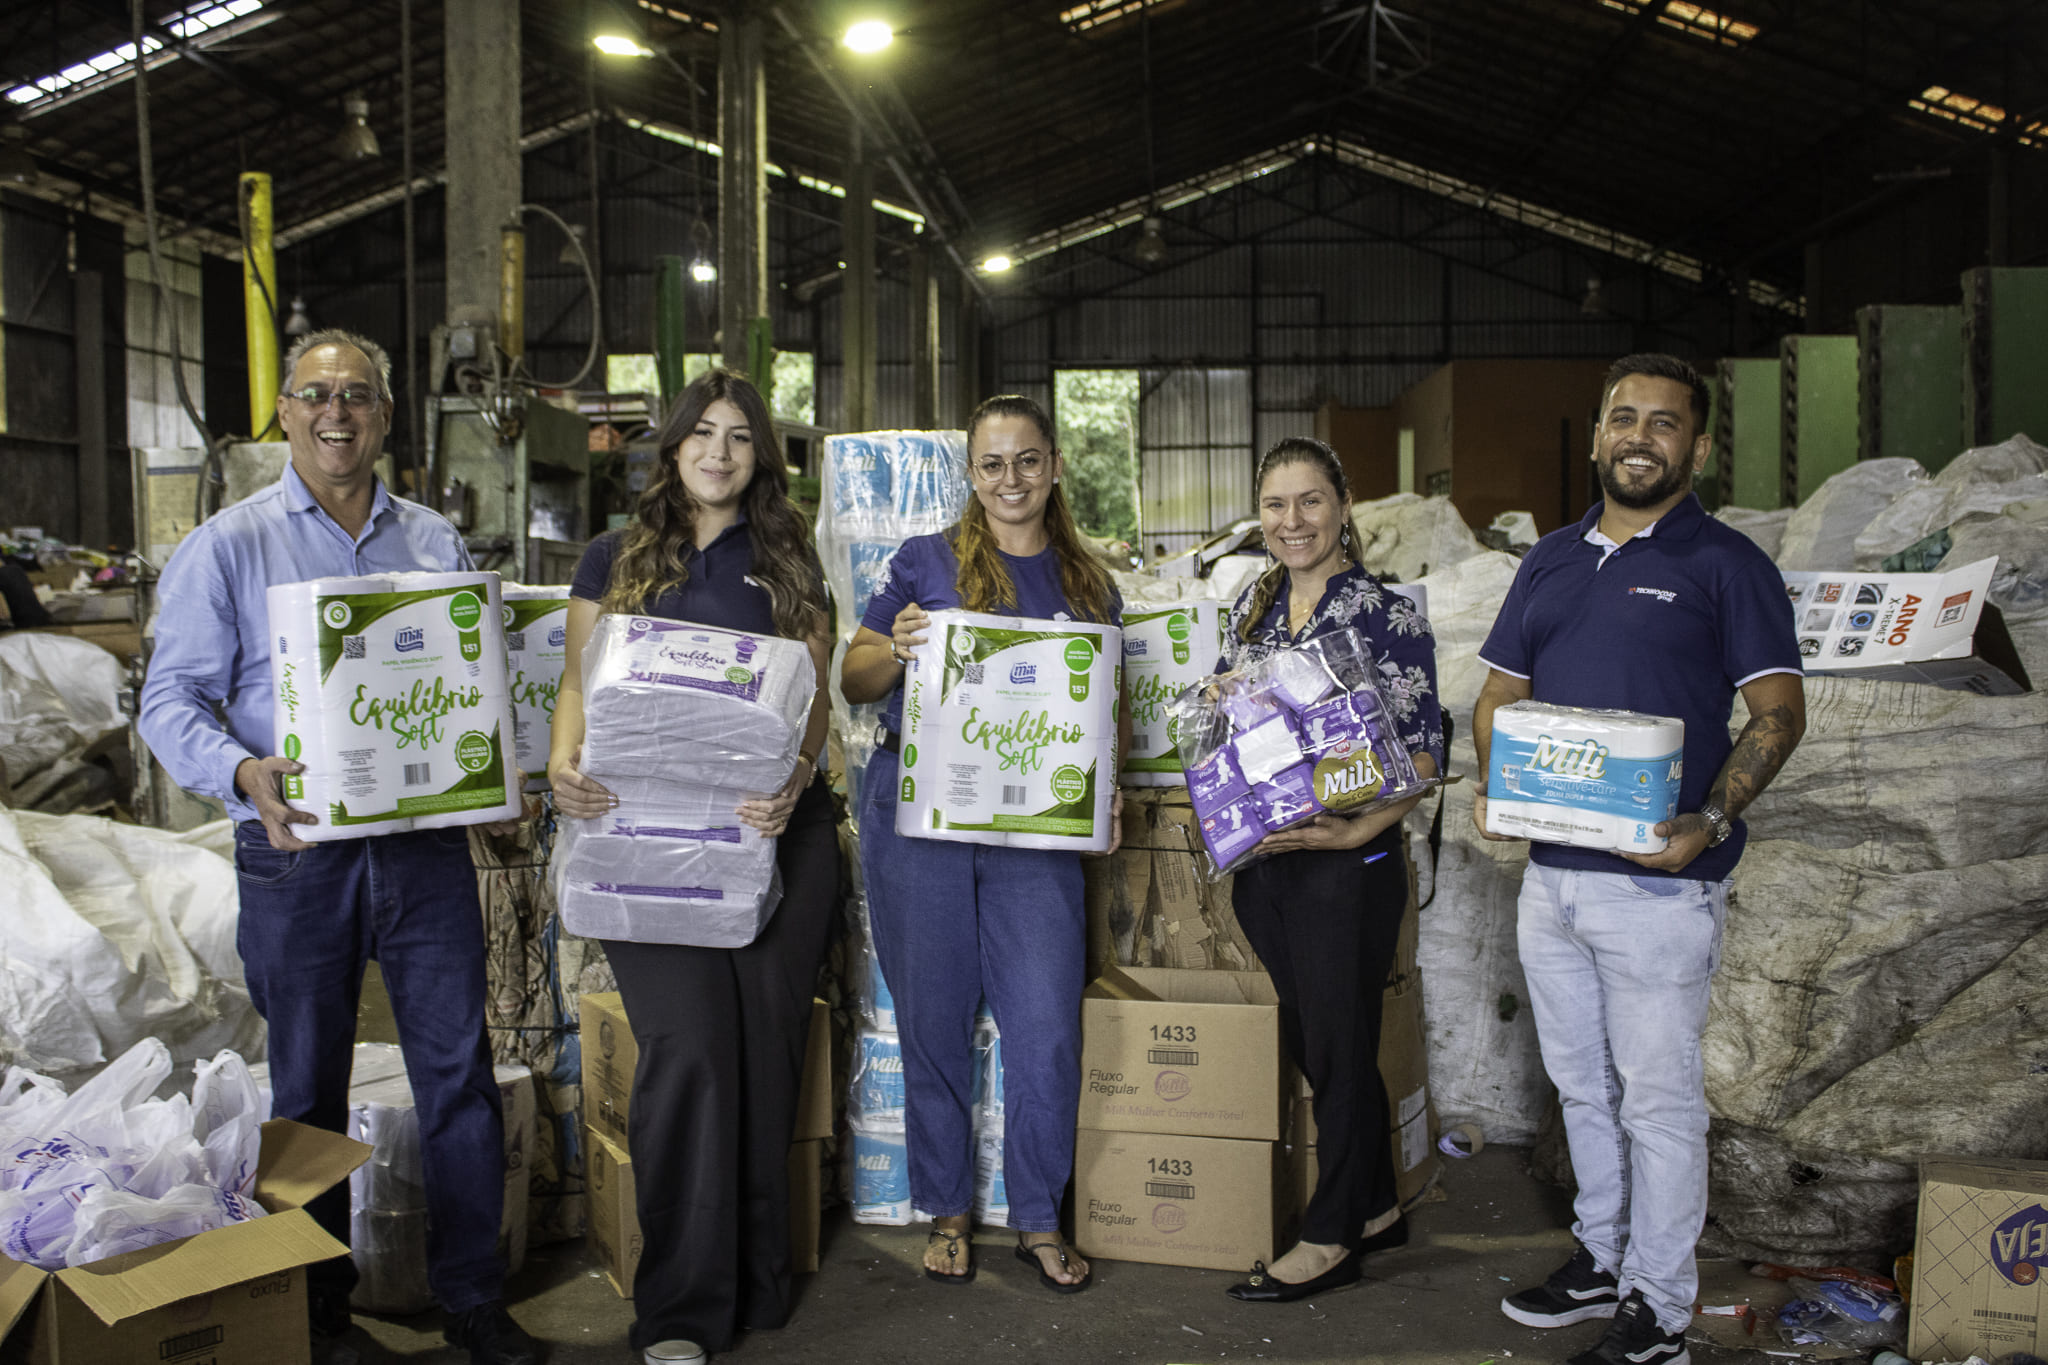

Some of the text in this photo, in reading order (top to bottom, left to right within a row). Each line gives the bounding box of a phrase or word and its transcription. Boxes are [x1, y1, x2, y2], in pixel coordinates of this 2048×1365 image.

[1888, 594, 1922, 646] ARNO
[463, 643, 478, 653] 151
[1072, 685, 1086, 694] 151
[350, 676, 483, 730] Equilíbrio
[391, 712, 448, 750] Soft
[962, 707, 1085, 751] Equilíbrio
[996, 739, 1050, 776] Soft
[1525, 735, 1608, 780] Mili
[288, 777, 298, 795] 151
[1322, 760, 1378, 801] Mili
[1636, 824, 1646, 838] 8
[1150, 1025, 1196, 1042] 1433
[1089, 1069, 1123, 1082] Fluxo
[1089, 1082, 1140, 1096] Regular
[856, 1154, 891, 1171] Mili
[1147, 1158, 1193, 1176] 1433
[1088, 1199, 1122, 1212] Fluxo
[1088, 1212, 1137, 1226] Regular
[250, 1278, 290, 1298] Fluxo
